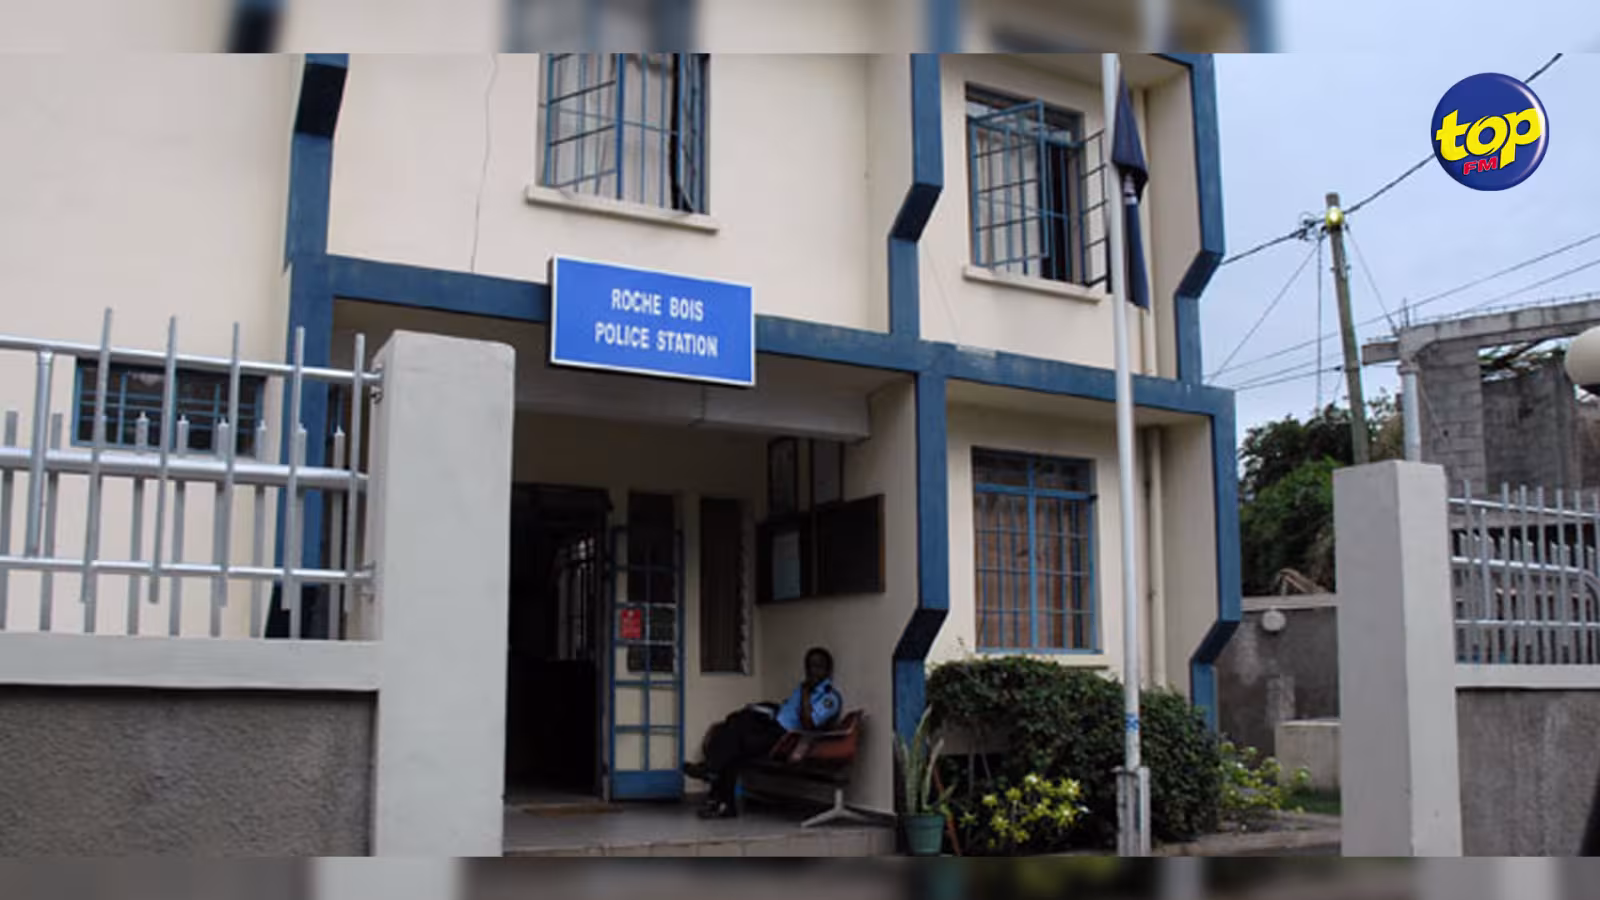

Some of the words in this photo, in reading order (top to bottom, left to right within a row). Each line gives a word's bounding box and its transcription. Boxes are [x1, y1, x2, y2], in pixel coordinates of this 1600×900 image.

[611, 288, 662, 316] ROCHE
[669, 296, 704, 322] BOIS
[594, 321, 650, 349] POLICE
[656, 330, 719, 358] STATION
